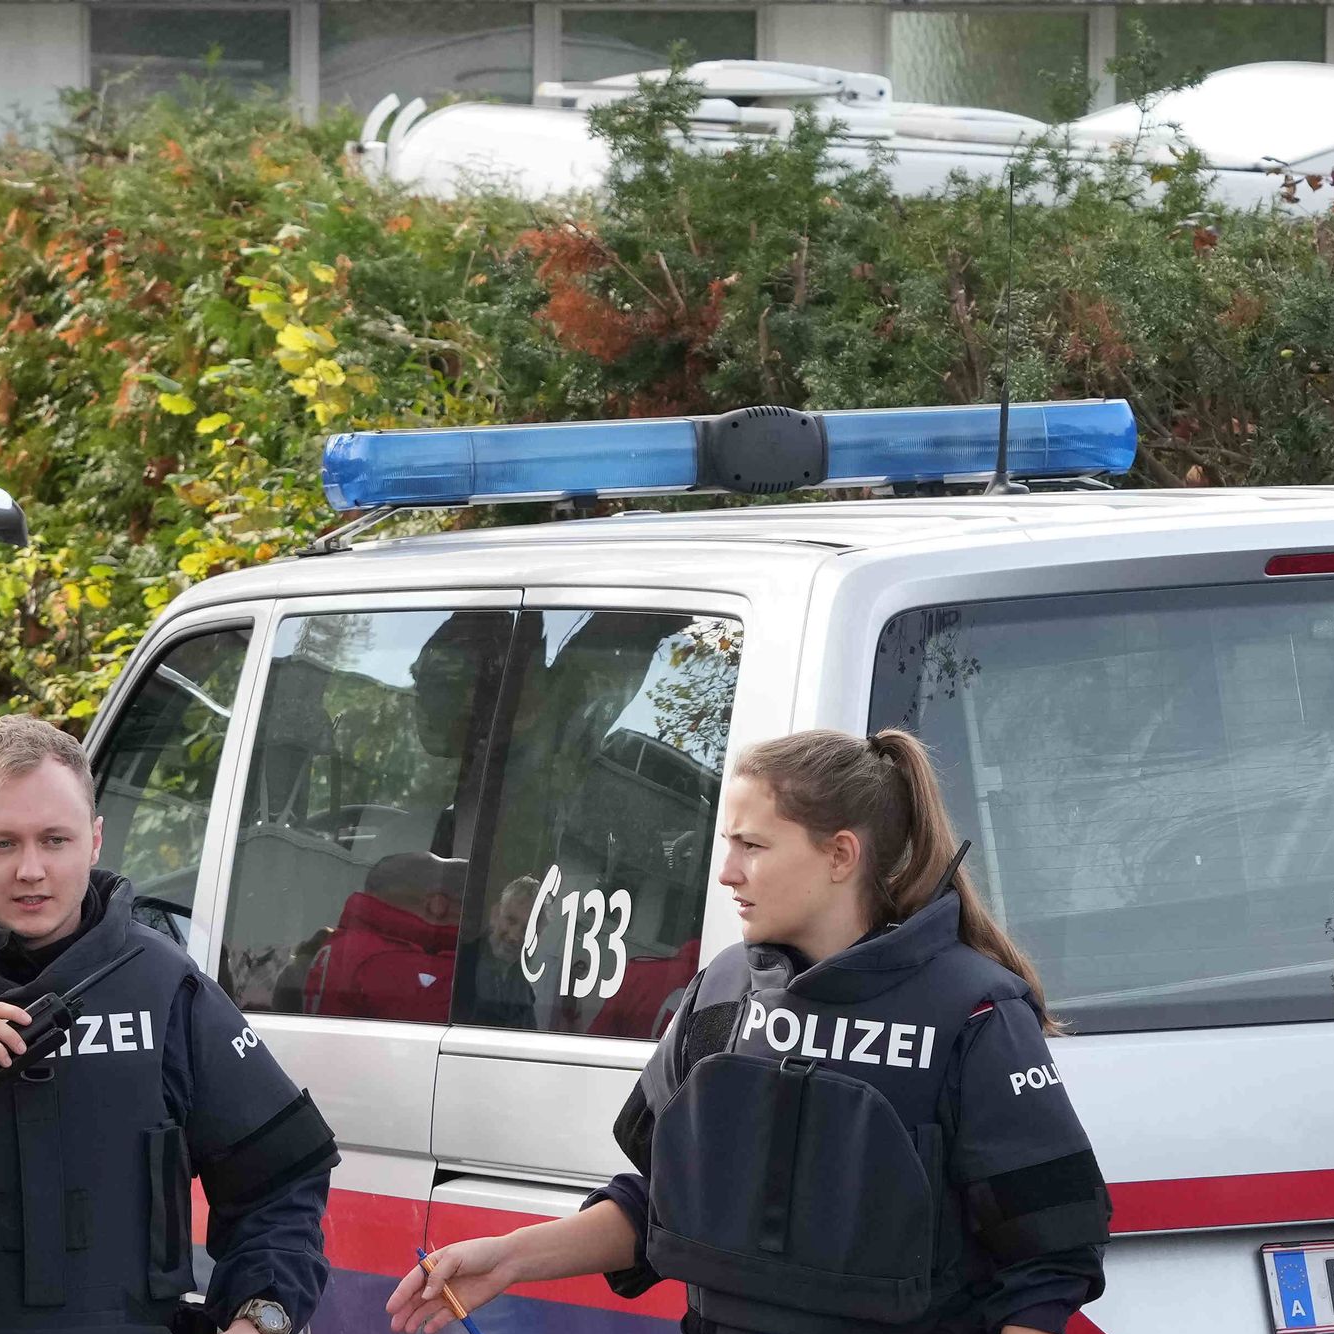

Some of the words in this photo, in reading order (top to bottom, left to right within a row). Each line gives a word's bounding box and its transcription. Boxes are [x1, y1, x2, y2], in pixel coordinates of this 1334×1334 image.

[559, 889, 632, 999] 133
[742, 999, 936, 1069] POLIZEI
[1009, 1062, 1062, 1096] POLI
[1292, 1299, 1307, 1317] A
